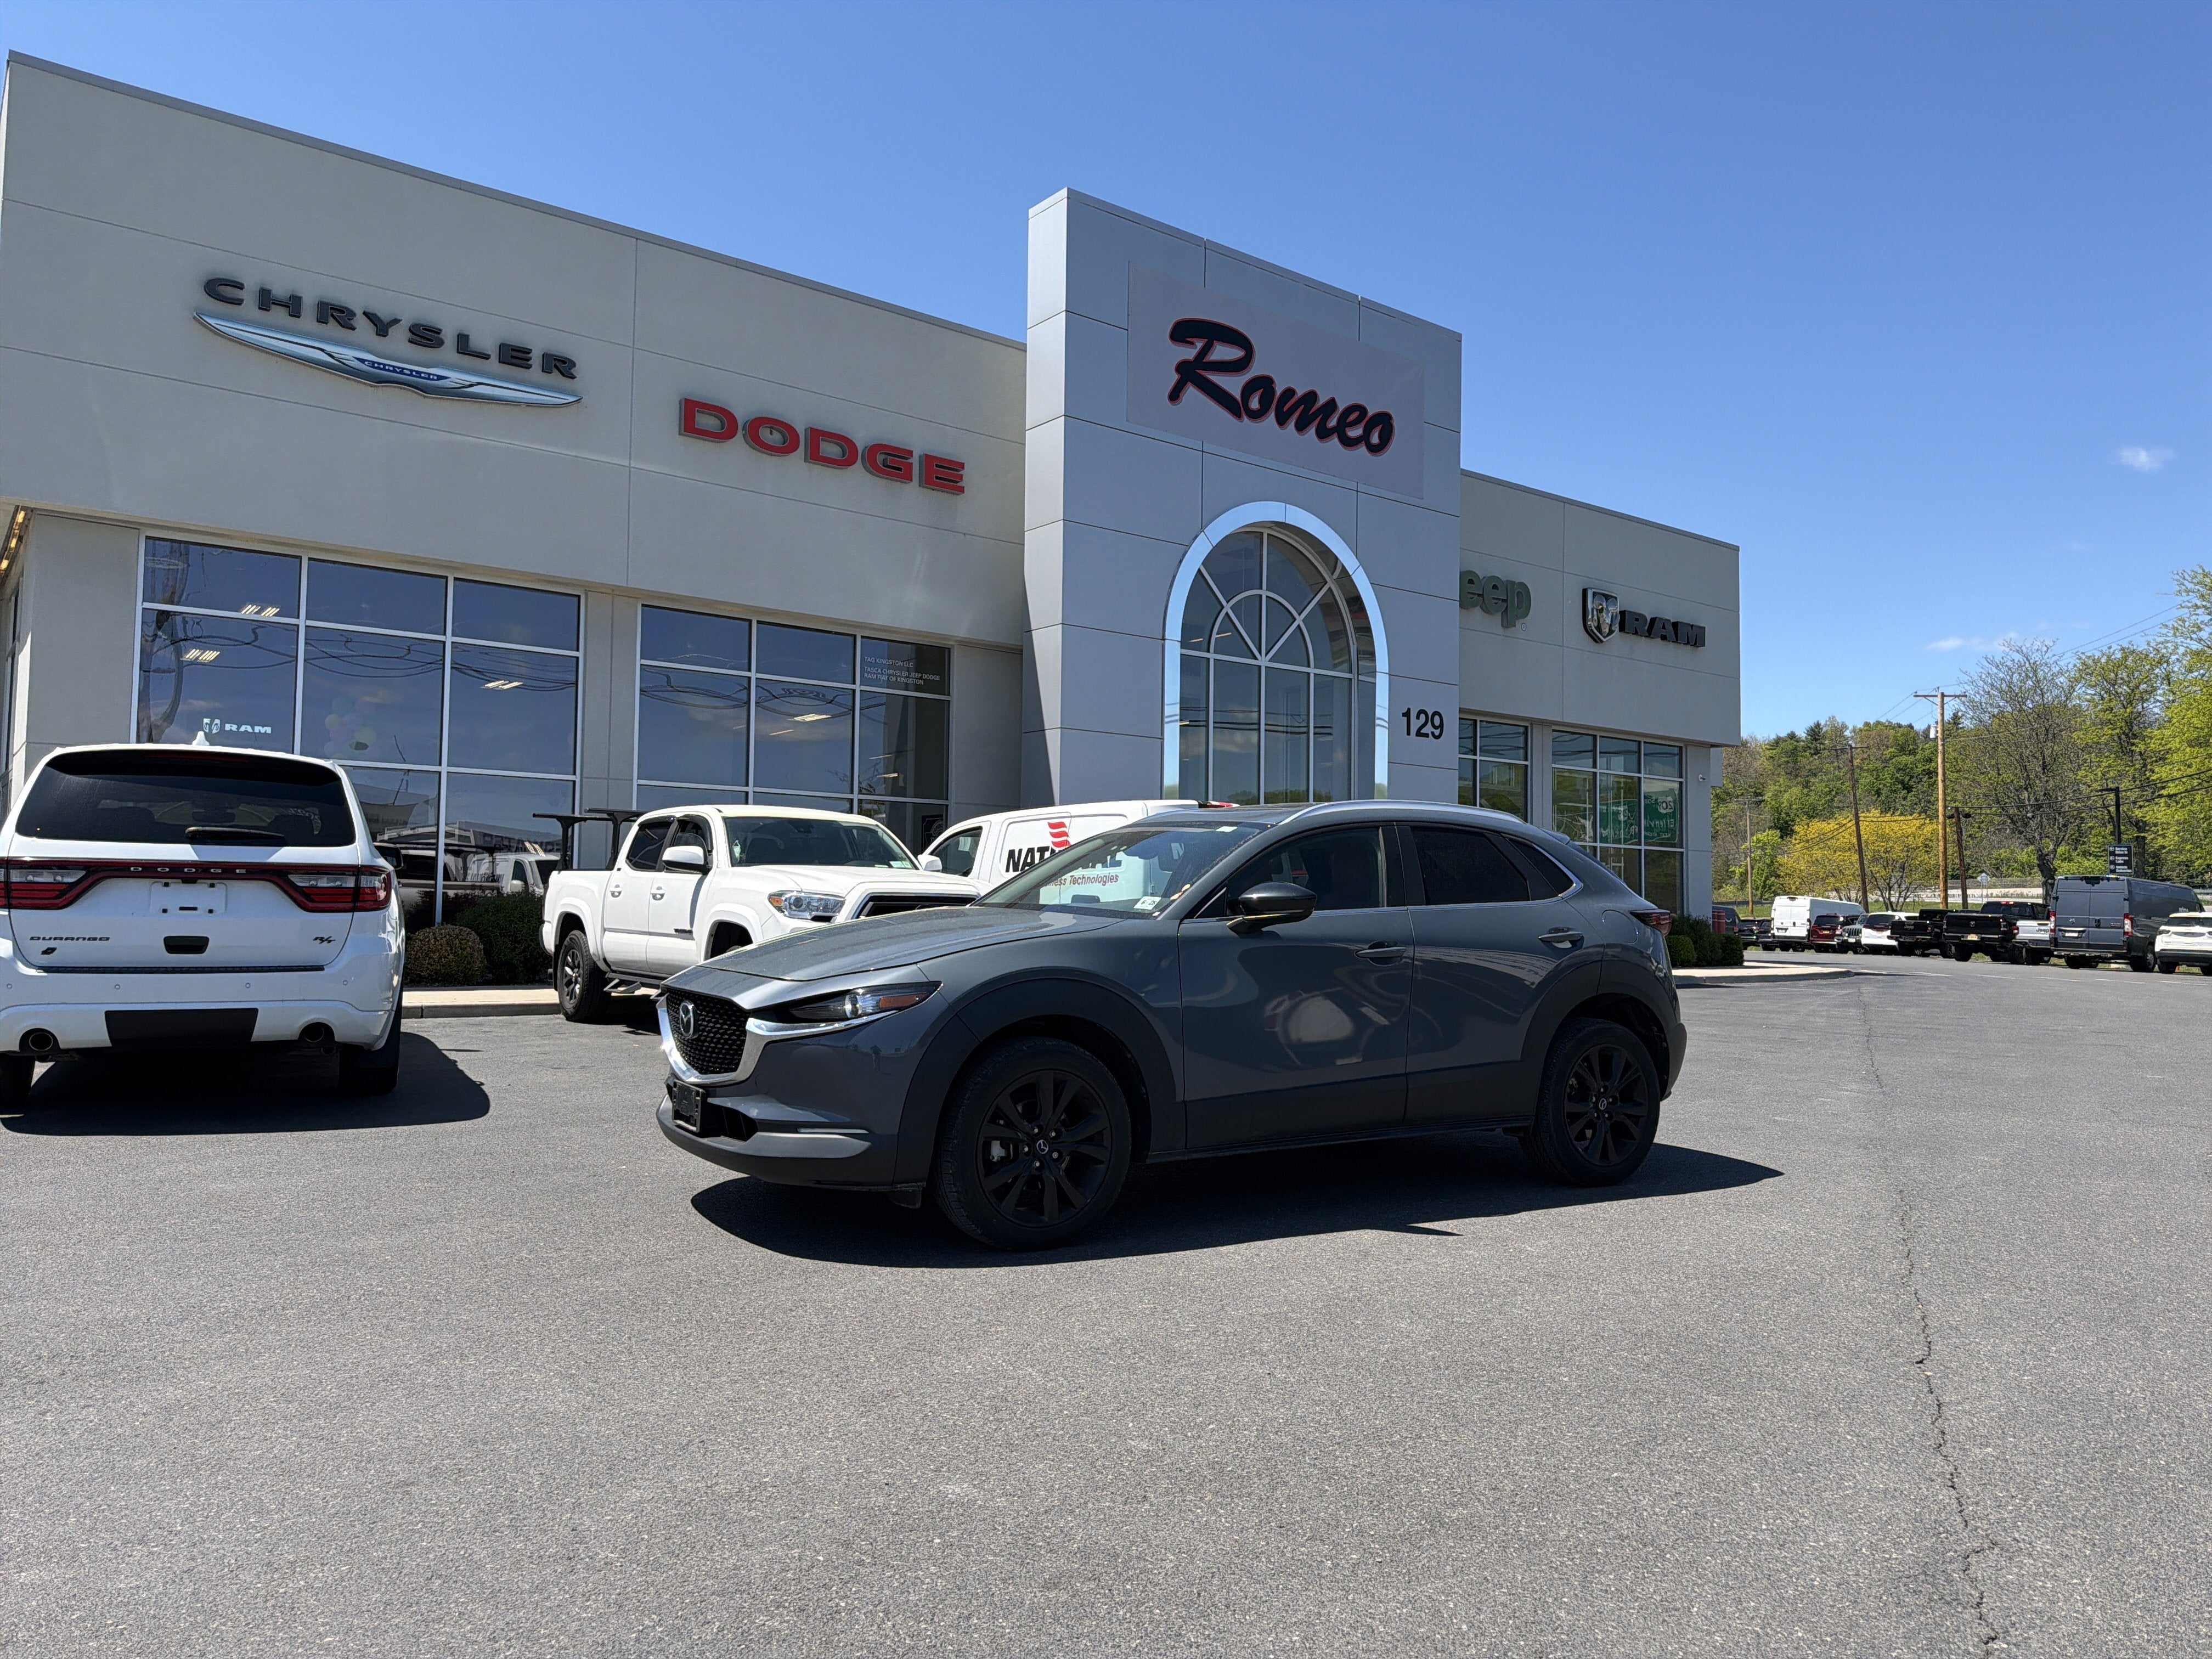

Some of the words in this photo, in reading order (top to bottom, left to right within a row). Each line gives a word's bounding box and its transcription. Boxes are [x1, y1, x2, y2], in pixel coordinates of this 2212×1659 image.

[204, 276, 578, 380] CHRYSLER
[364, 360, 438, 380] CHRYSLER
[1167, 317, 1395, 456] Romeo
[679, 397, 965, 495] DODGE
[1459, 570, 1531, 629] eep
[1619, 610, 1706, 647] RAM
[876, 658, 903, 667] KINGSTON
[882, 668, 909, 677] CHRYSLER
[897, 676, 924, 685] KINGSTON
[225, 723, 272, 733] RAM
[1402, 707, 1444, 740] 129
[1069, 872, 1120, 887] Technologies
[313, 935, 336, 944] R/T
